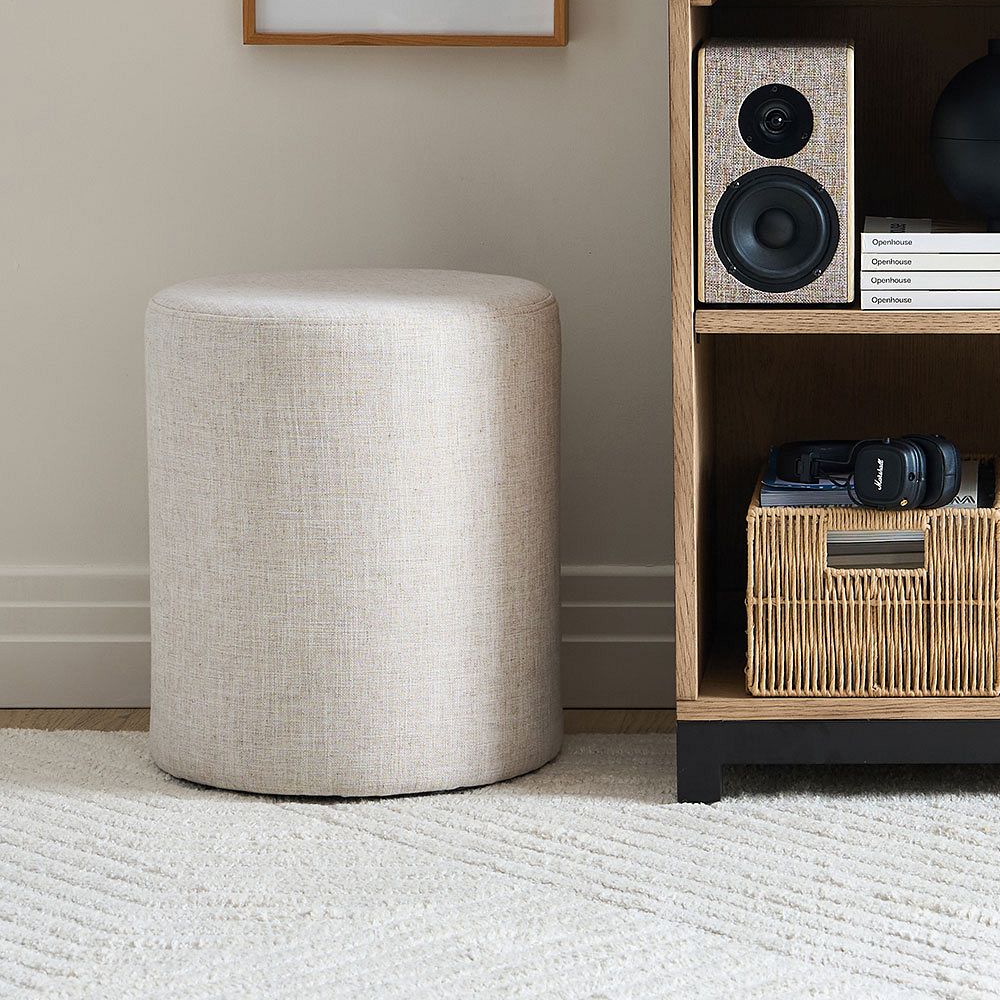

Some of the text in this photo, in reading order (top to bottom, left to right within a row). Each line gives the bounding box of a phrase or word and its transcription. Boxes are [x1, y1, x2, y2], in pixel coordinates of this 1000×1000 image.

[872, 238, 913, 247] Openhouse
[871, 258, 912, 266] Openhouse
[871, 277, 911, 285] Openhouse
[871, 296, 912, 304] Openhouse
